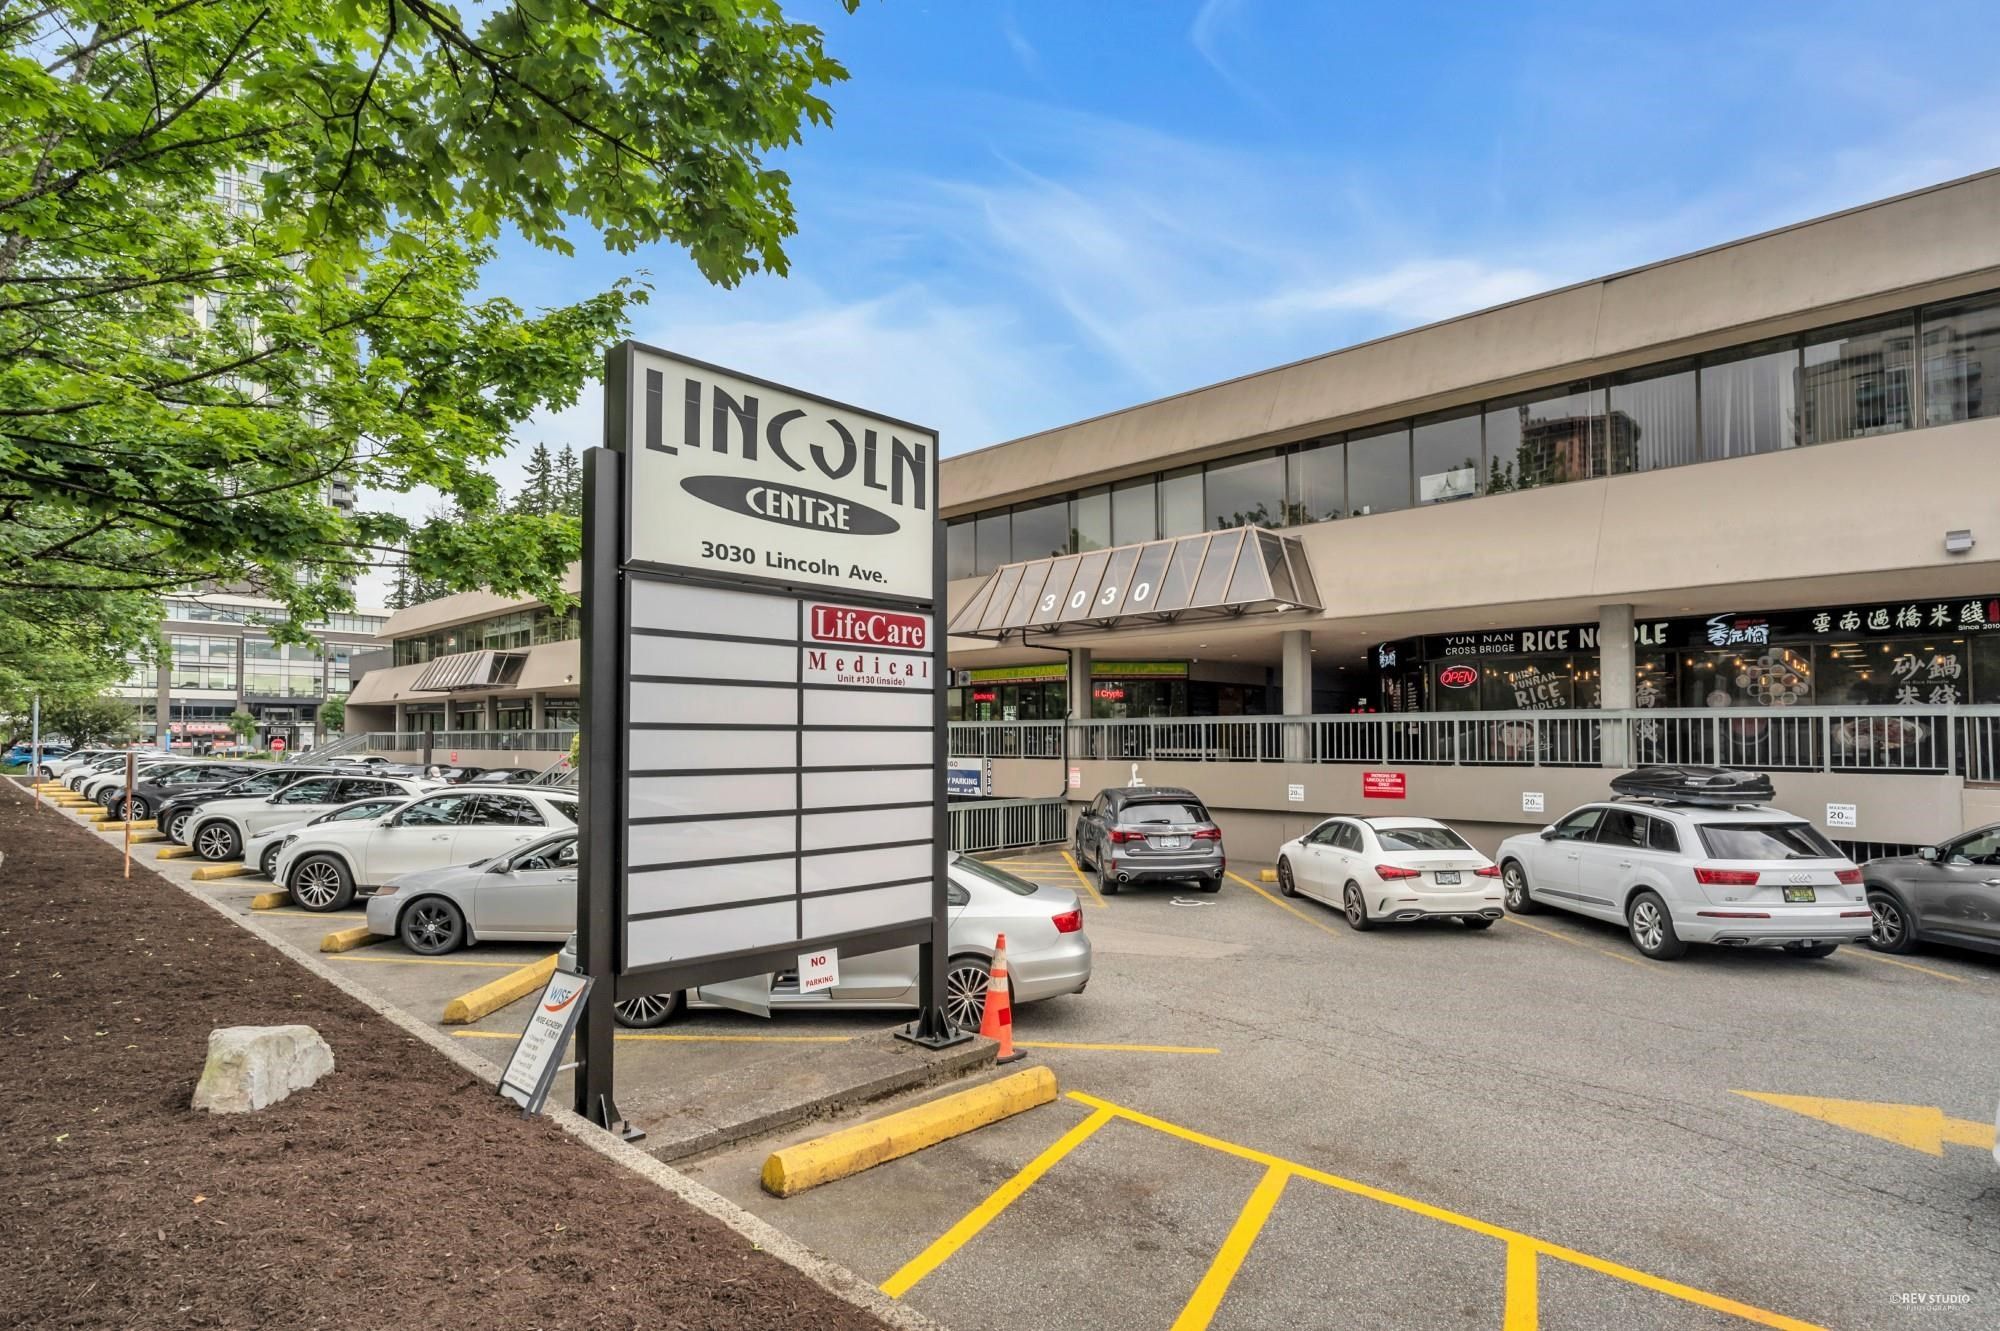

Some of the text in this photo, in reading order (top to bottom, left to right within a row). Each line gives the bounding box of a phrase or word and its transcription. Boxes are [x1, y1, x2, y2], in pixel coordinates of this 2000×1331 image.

[646, 368, 926, 510] LINCOLN
[746, 486, 850, 531] CENTRE
[701, 541, 888, 584] 3030 Lincoln Ave.
[1041, 582, 1150, 612] 3030
[816, 609, 923, 646] LifeCare
[1522, 623, 1669, 652] RICE NLE
[1446, 633, 1514, 645] YUN NAN
[1446, 644, 1515, 656] CROSS BRIDGE
[809, 651, 927, 678] Medical
[857, 676, 874, 684] #130
[877, 678, 906, 686] (inside)
[1442, 671, 1474, 682] OPEN
[1515, 682, 1561, 707] RICE
[952, 778, 978, 786] PARKING
[811, 956, 826, 967] NO
[806, 975, 833, 988] PARKING
[550, 985, 571, 1002] WISE
